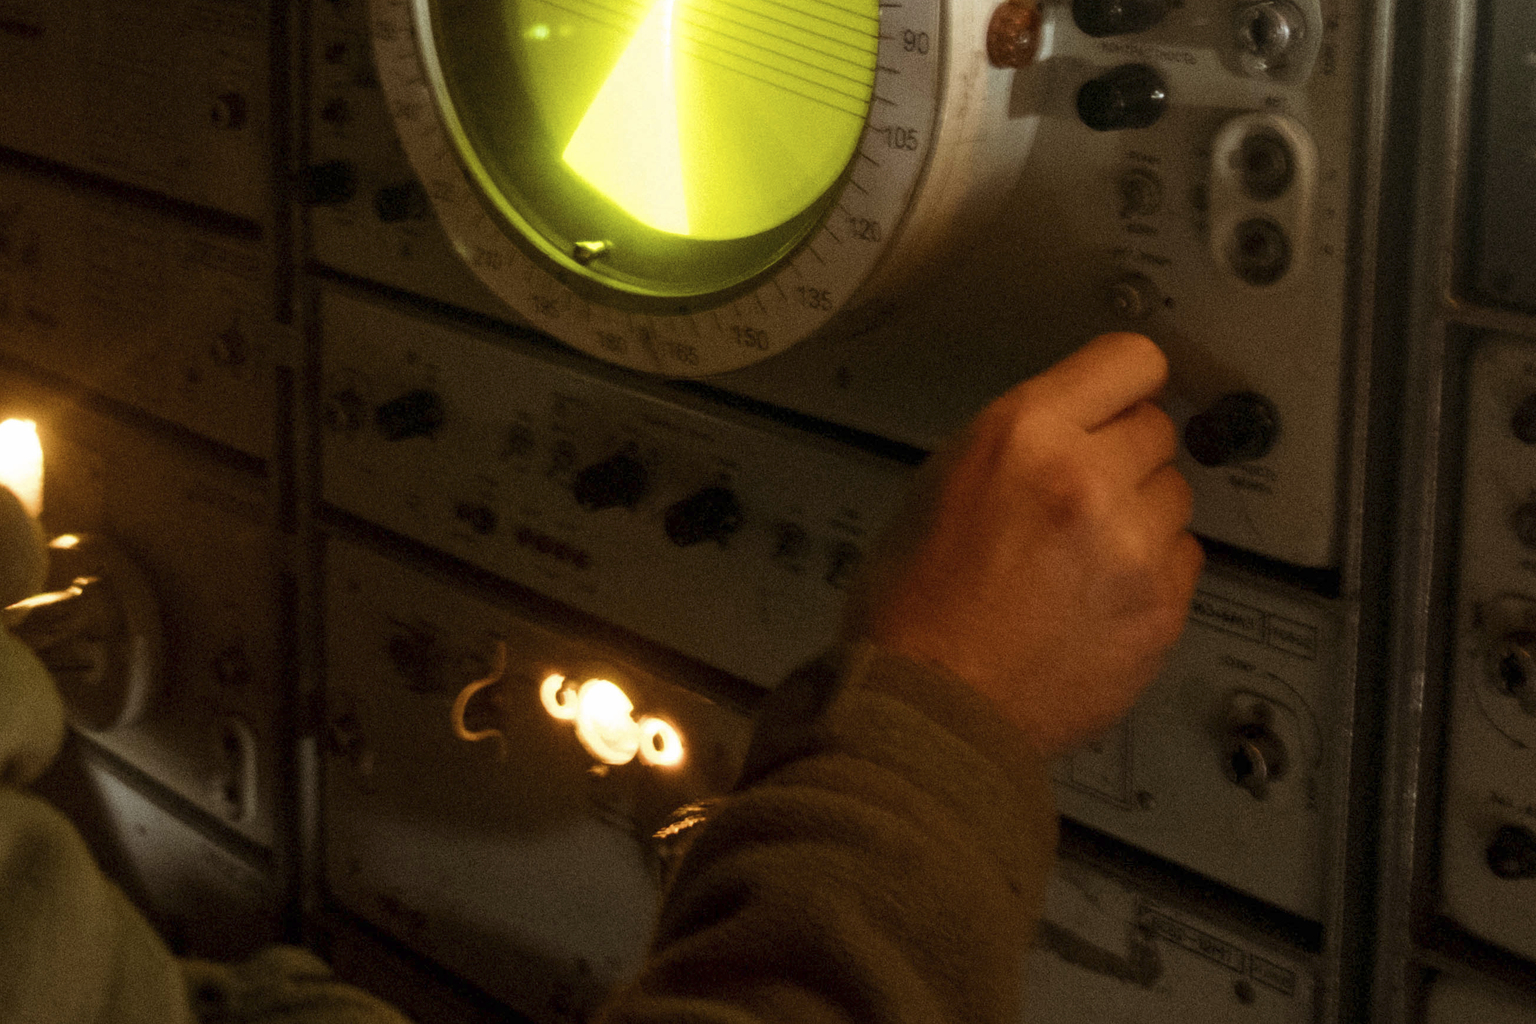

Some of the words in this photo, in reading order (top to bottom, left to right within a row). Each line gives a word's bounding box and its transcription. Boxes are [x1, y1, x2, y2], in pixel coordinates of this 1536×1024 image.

[902, 27, 931, 57] 90
[883, 124, 920, 153] 105
[849, 216, 882, 244] 120
[795, 285, 833, 313] 135
[730, 324, 770, 352] 150
